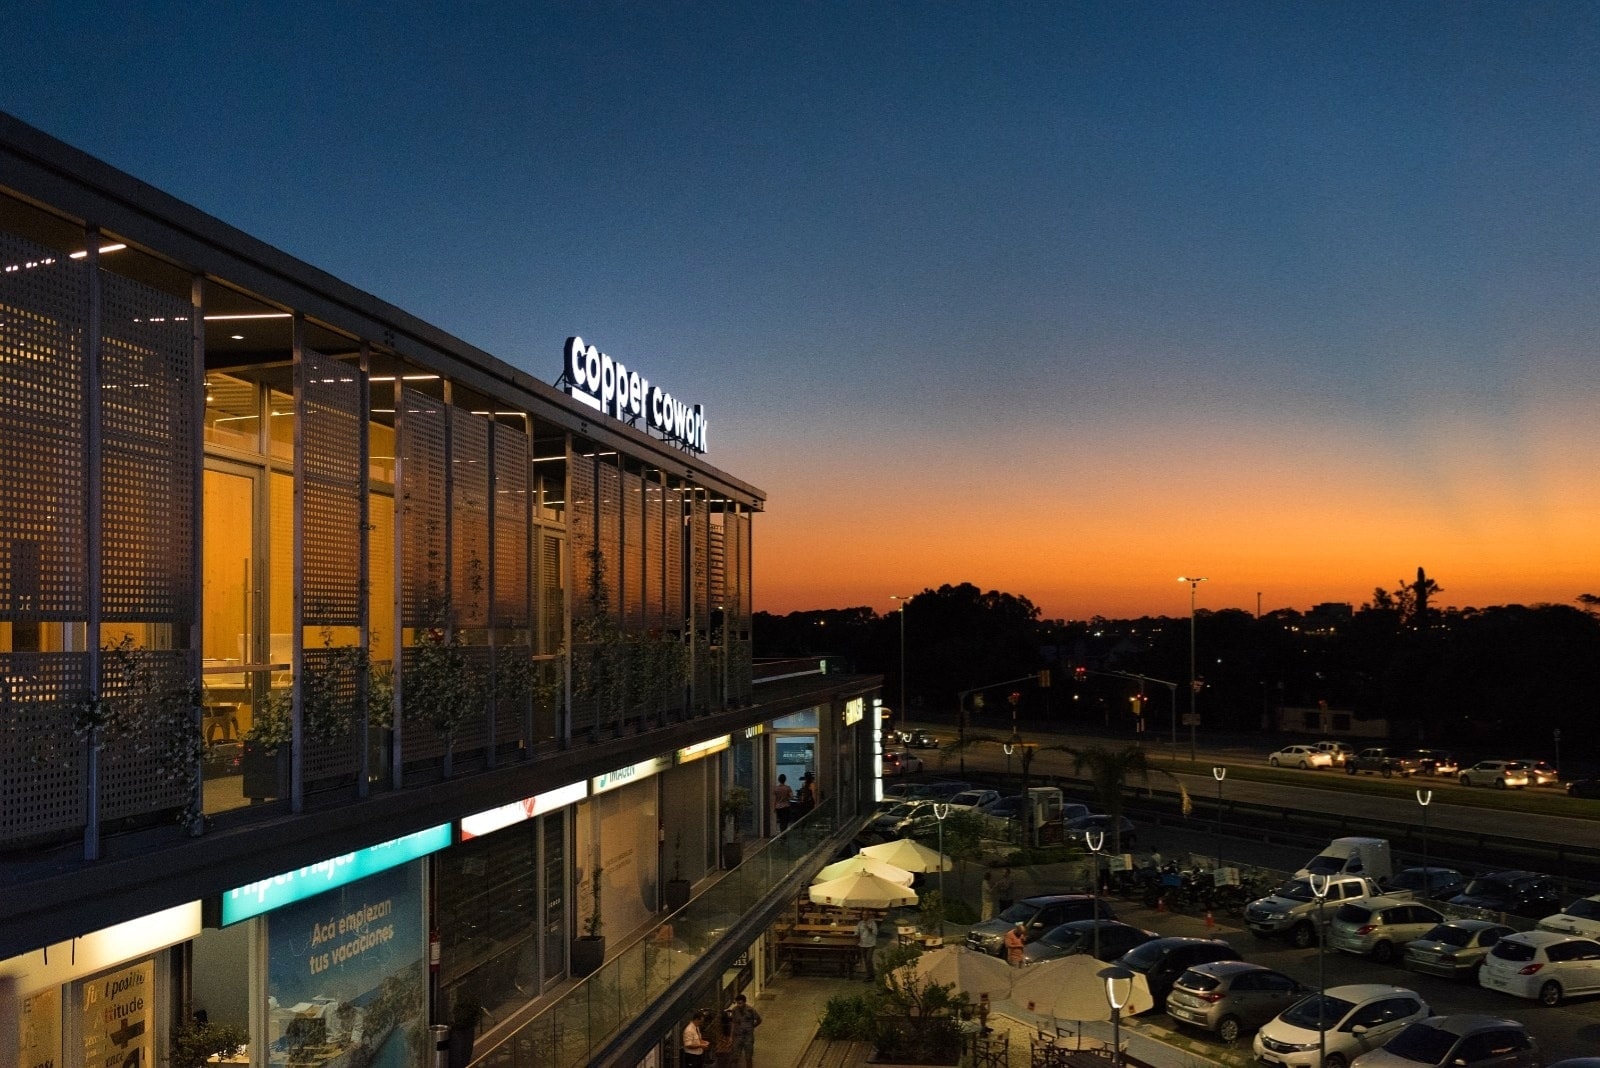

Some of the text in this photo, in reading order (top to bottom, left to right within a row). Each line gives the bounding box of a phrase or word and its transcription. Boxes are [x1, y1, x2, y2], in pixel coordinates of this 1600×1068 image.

[570, 336, 707, 454] copper cowork
[311, 899, 392, 947] Acá empiezan
[310, 924, 394, 975] tus vacaciones
